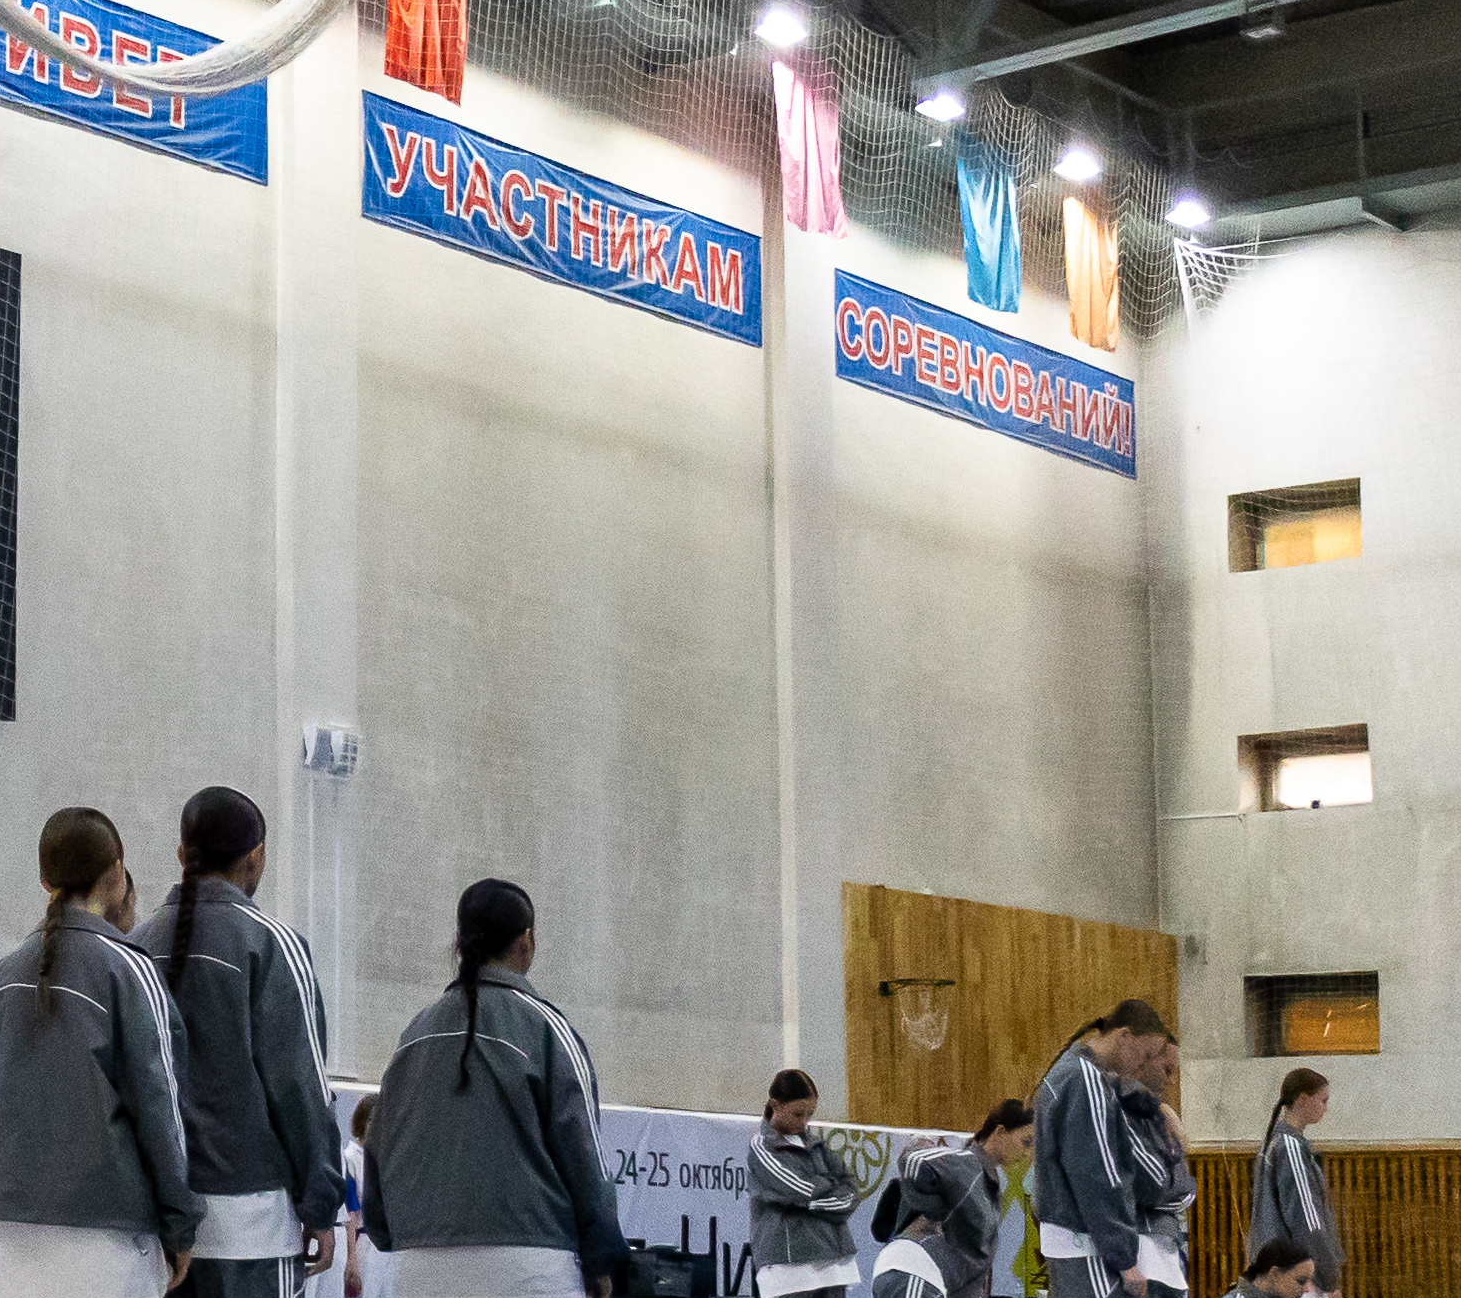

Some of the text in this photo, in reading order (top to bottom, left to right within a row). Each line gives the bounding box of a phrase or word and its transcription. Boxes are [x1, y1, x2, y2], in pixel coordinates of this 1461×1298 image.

[382, 122, 745, 316] УЧАСТНИКАМ
[837, 299, 1133, 459] СОРЕВНОВАНИЙ!
[614, 1148, 748, 1200] 24-25 октябр
